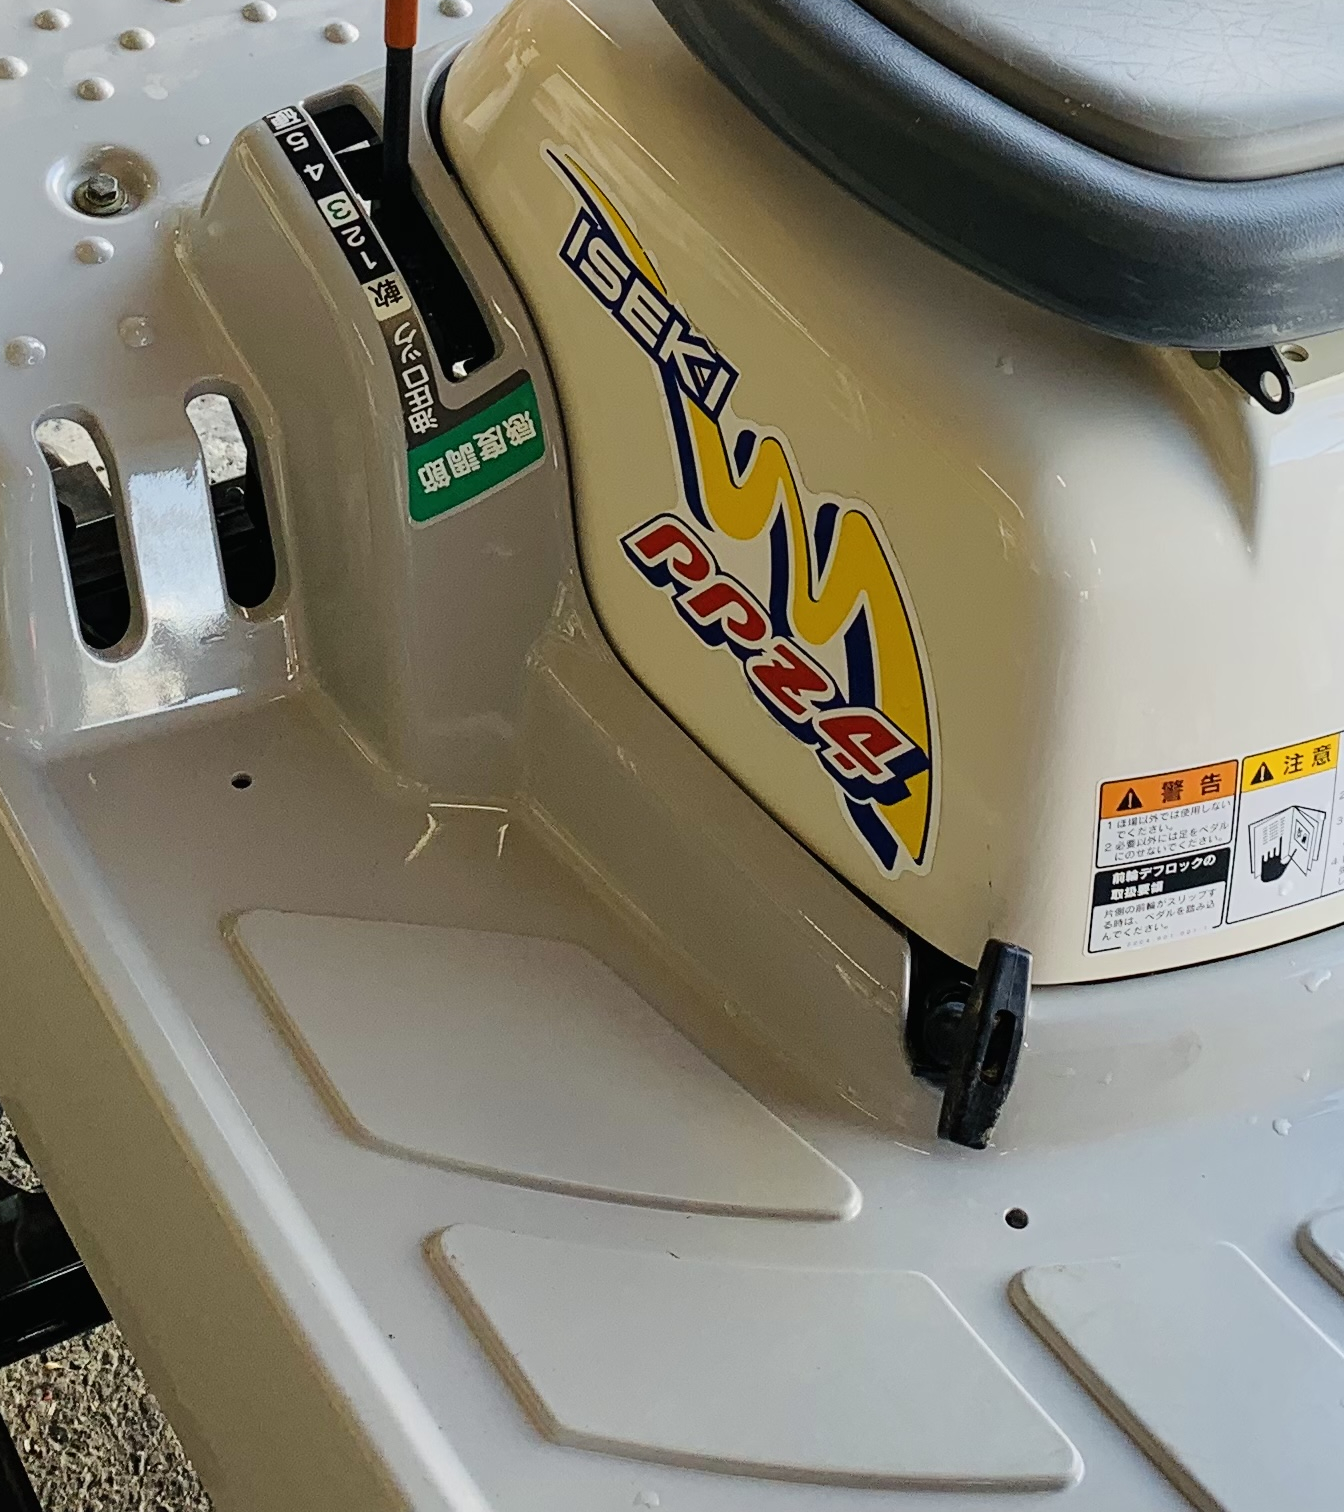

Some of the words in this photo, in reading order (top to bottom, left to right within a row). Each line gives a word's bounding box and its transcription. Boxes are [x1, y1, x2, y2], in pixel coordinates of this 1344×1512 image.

[286, 132, 309, 152] 5
[302, 162, 325, 182] 4
[327, 198, 351, 221] 3
[341, 225, 367, 247] 2
[360, 250, 378, 271] 1
[367, 278, 404, 308] 軟
[564, 213, 734, 418] ISEKI
[392, 321, 439, 435] 油圧ロック
[417, 409, 538, 495] 感度調節
[628, 518, 912, 790] PPZ4
[1283, 744, 1332, 775] 注意
[1161, 772, 1222, 804] 警告
